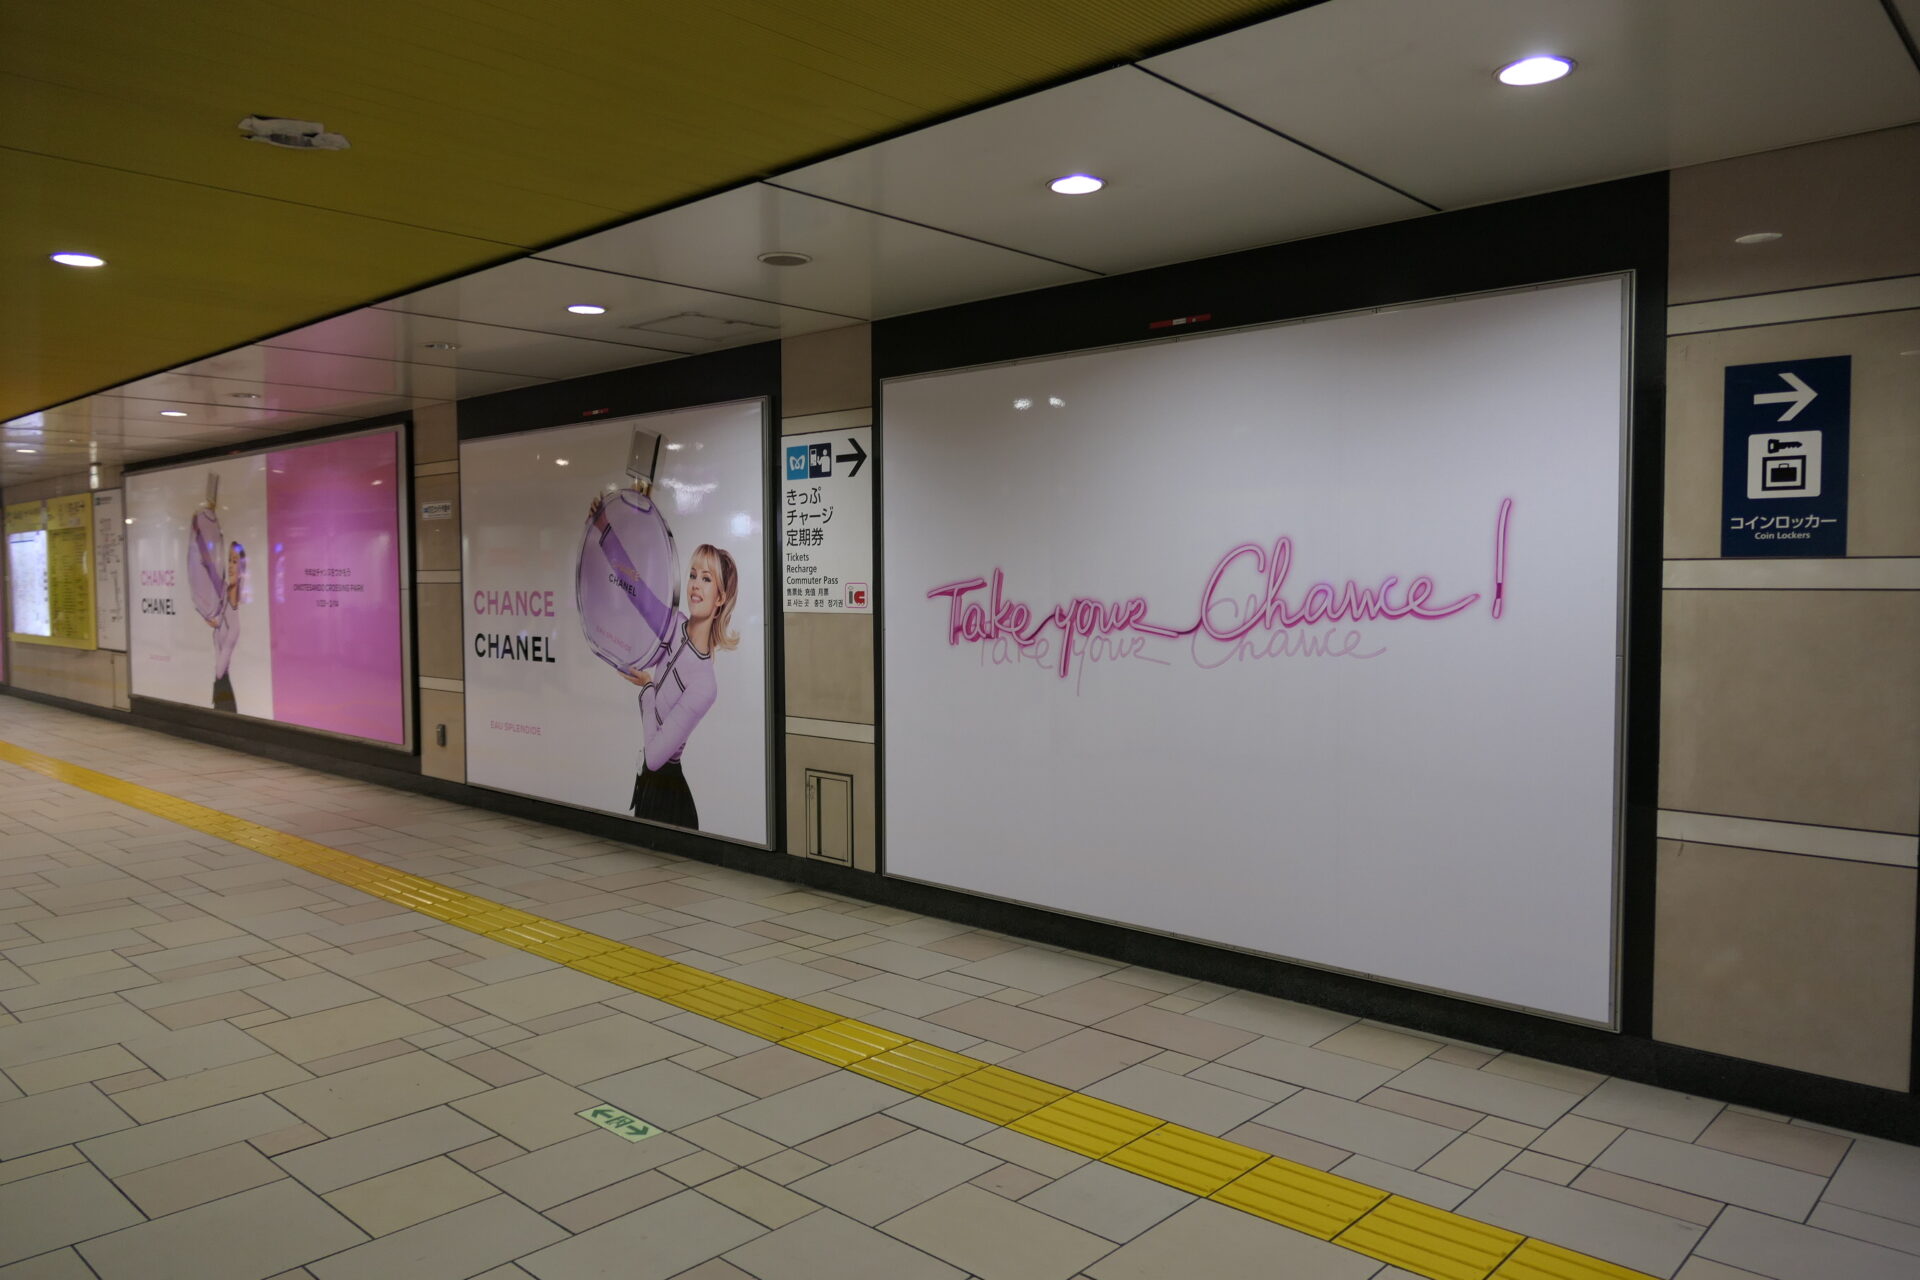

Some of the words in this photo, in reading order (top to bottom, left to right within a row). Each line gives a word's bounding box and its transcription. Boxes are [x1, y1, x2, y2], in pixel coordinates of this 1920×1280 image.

[786, 486, 821, 506] きっぷ
[786, 506, 834, 526] チャージ
[1730, 514, 1837, 530] コインロッカー
[786, 527, 824, 547] 定期券
[1754, 531, 1775, 540] Coin
[1777, 531, 1811, 539] Lockers
[786, 552, 810, 562] Tickets
[141, 570, 175, 586] CHANCE
[786, 564, 817, 576] Recharge
[608, 574, 637, 597] CHANEL
[786, 576, 822, 585] Commuter
[823, 576, 839, 585] Pass
[141, 598, 176, 615] CHANEL
[473, 590, 555, 617] CHANCE
[926, 567, 1037, 646] Take
[1052, 598, 1180, 678] your
[474, 633, 556, 663] CHANEL
[490, 720, 503, 730] EAU
